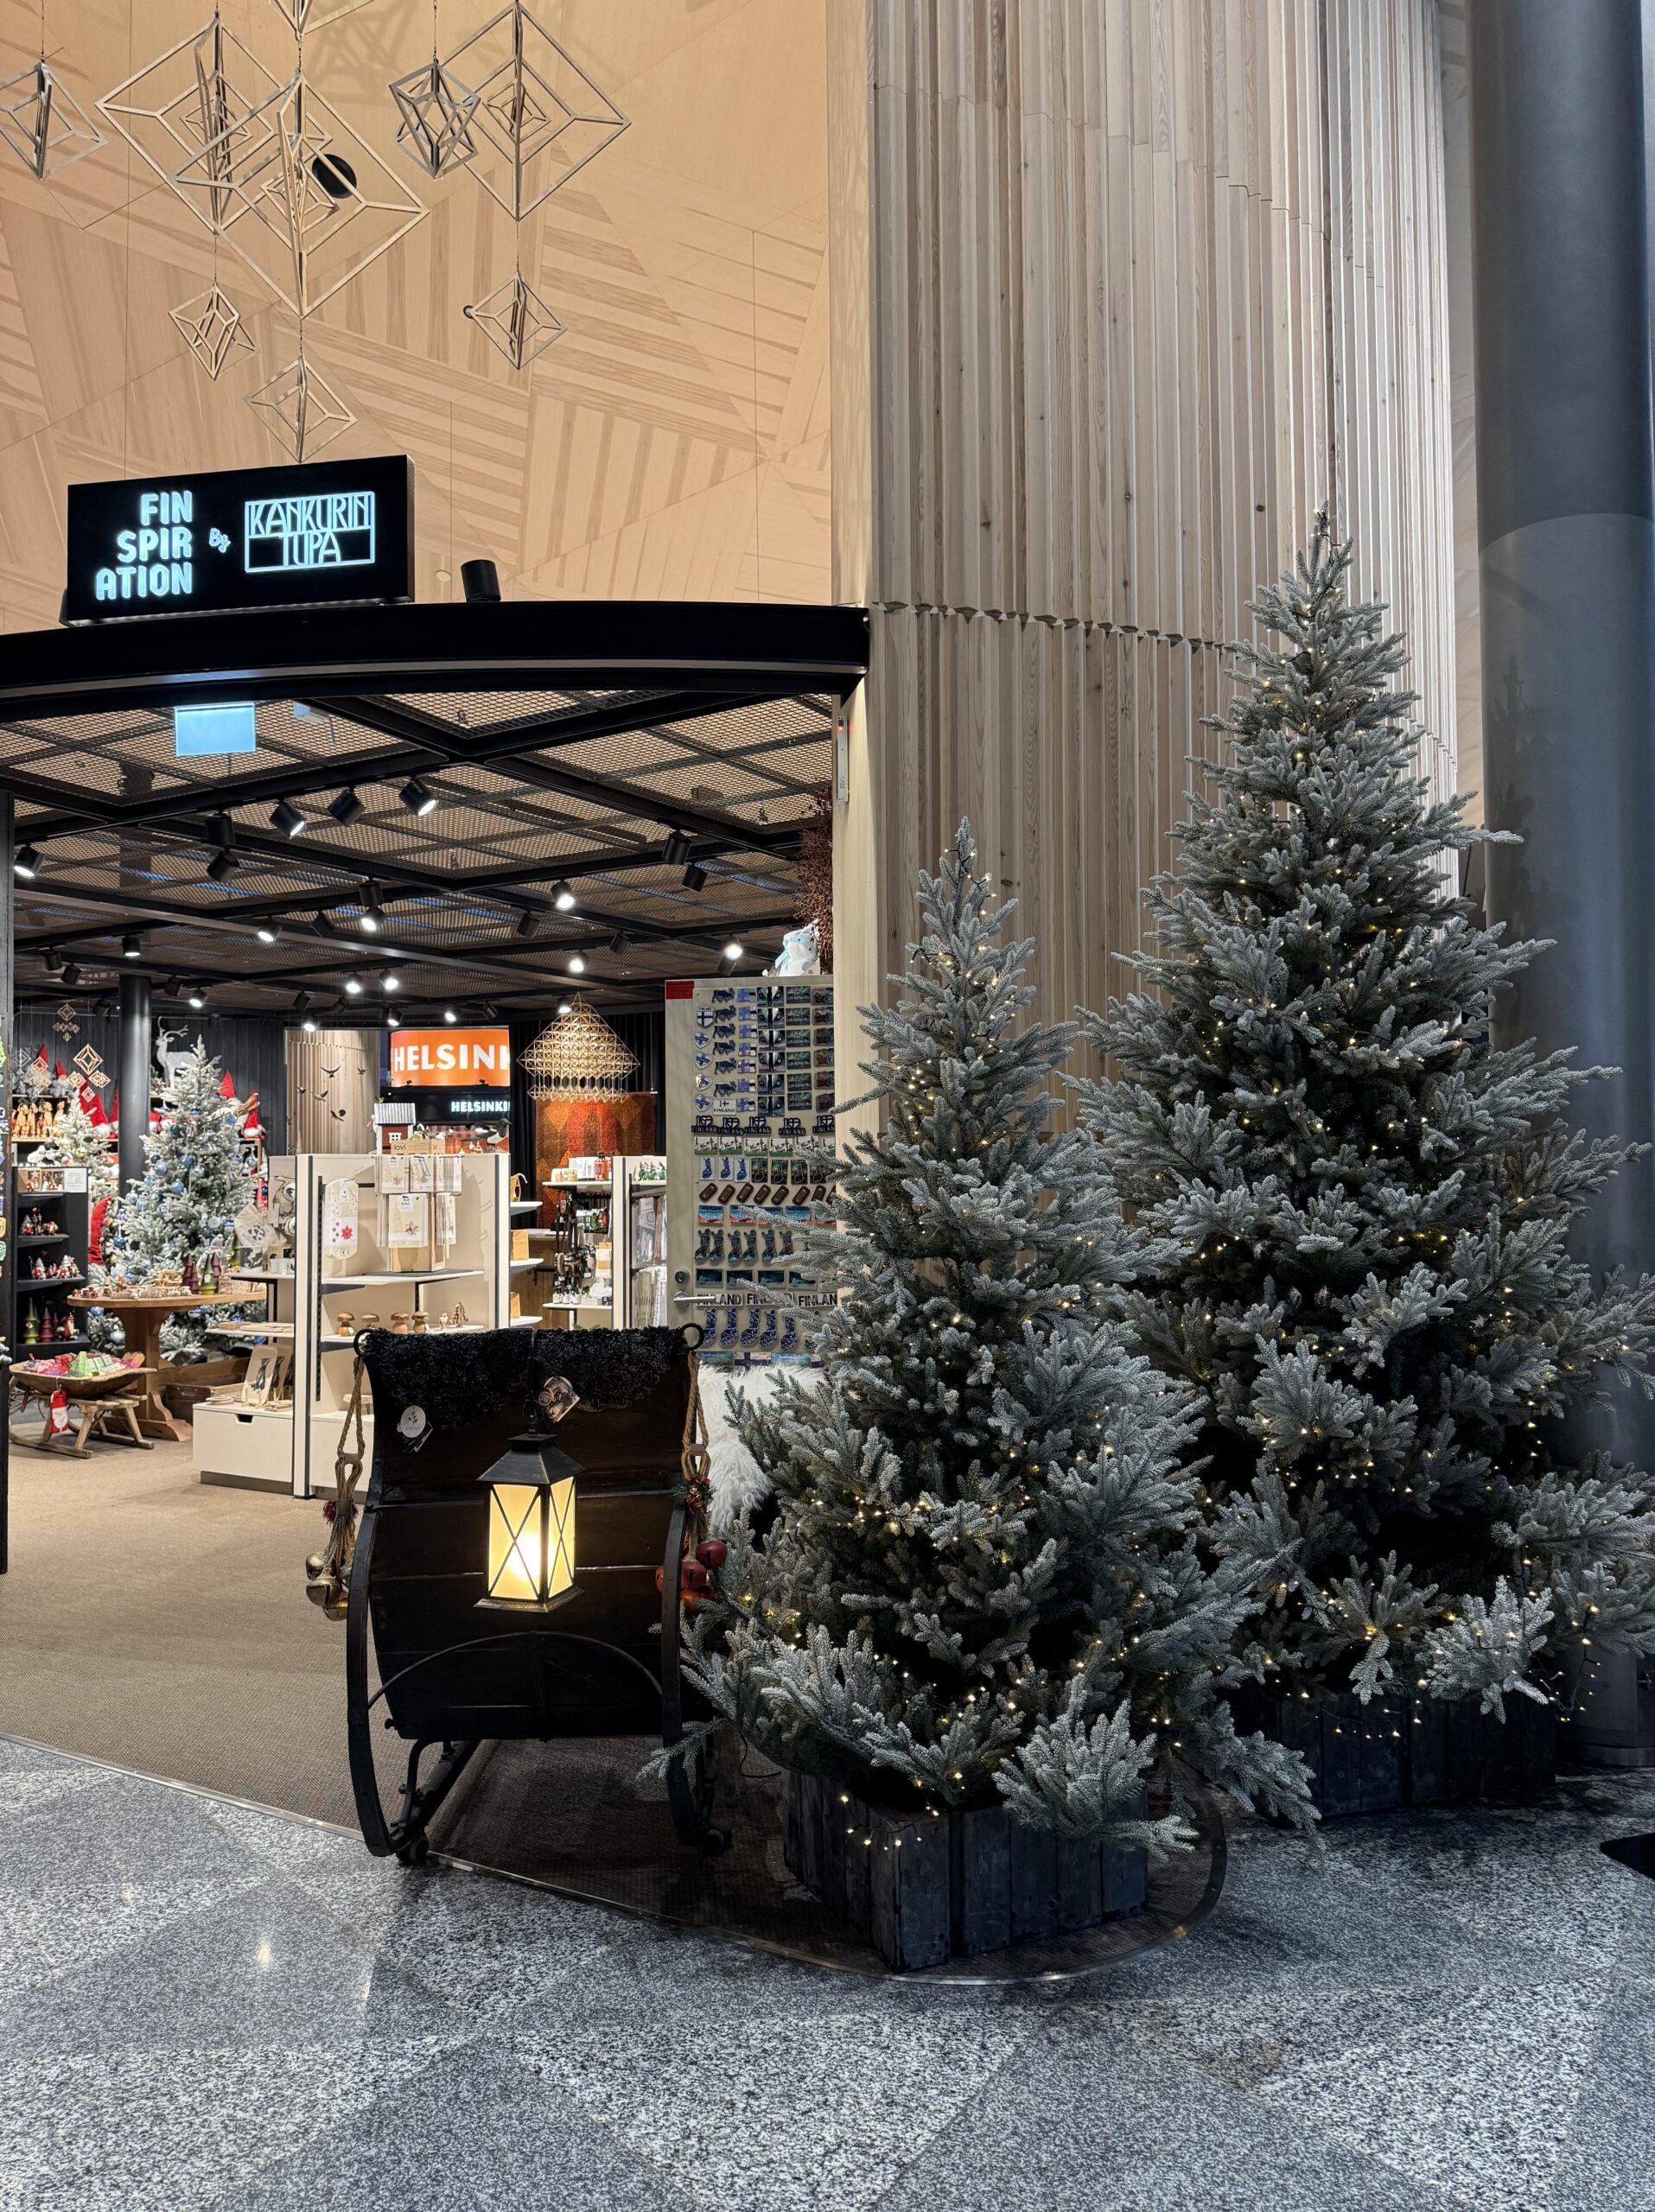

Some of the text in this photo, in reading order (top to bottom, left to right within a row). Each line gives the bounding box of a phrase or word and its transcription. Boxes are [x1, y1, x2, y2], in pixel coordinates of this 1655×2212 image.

[140, 490, 192, 525] FIN
[250, 493, 369, 536] KANKURIN
[117, 526, 192, 563] SPIR
[208, 527, 231, 553] By
[278, 531, 341, 568] TUPA
[96, 562, 192, 601] ATION
[394, 1044, 510, 1071] HELSINK
[451, 1101, 511, 1112] HELSINKI
[799, 1294, 837, 1306] FINLAN
